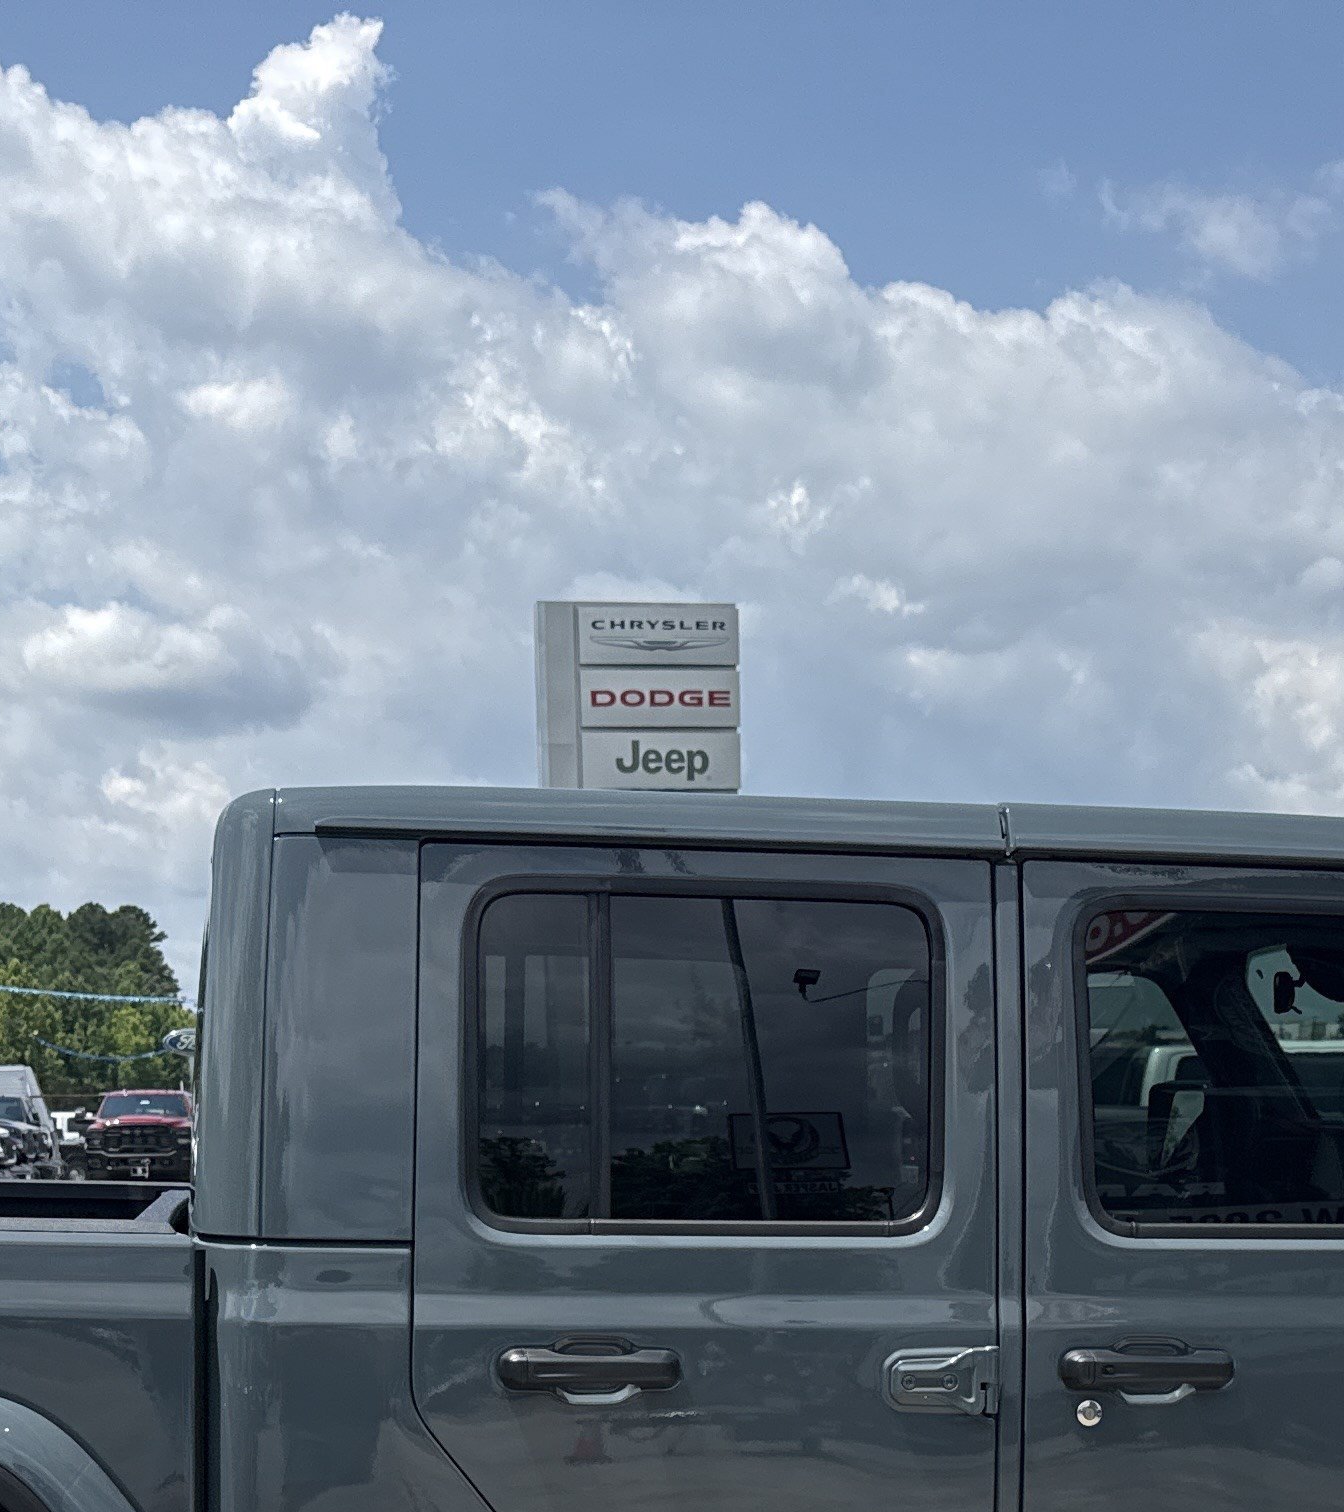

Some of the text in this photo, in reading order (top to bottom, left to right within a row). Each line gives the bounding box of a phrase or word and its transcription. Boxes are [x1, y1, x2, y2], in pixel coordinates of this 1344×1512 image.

[591, 620, 727, 631] CHRYSLER
[590, 690, 731, 708] DODGE
[615, 739, 710, 781] Jeep
